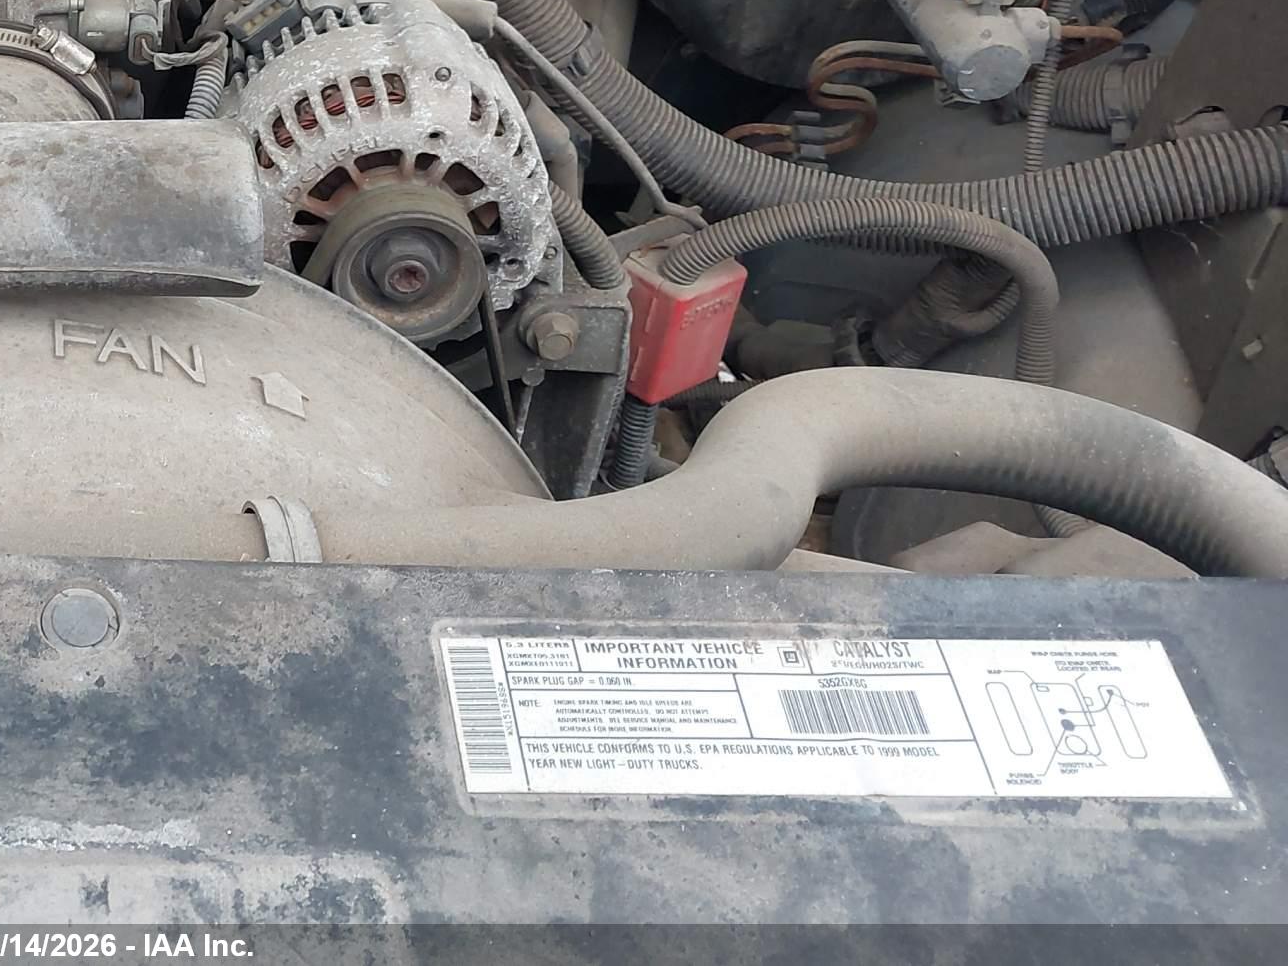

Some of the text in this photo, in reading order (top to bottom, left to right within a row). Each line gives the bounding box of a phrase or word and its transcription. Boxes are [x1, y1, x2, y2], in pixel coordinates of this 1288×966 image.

[53, 319, 208, 385] FAN
[583, 641, 764, 655] IMPORTANT VEHICLE
[831, 640, 913, 658] CATALYST
[616, 657, 739, 669] INFORMATION
[511, 676, 540, 686] SPARK
[542, 676, 564, 686] PLUG
[567, 676, 584, 686] GAP
[524, 740, 940, 757] THIS VEHICLE CONFORMS TO U.S. EPA REGULATIONS APPLICABLE TO 1999 MODEL
[527, 758, 557, 769] YEAR
[558, 758, 582, 769] NEW
[657, 758, 703, 770] TRUCKS.
